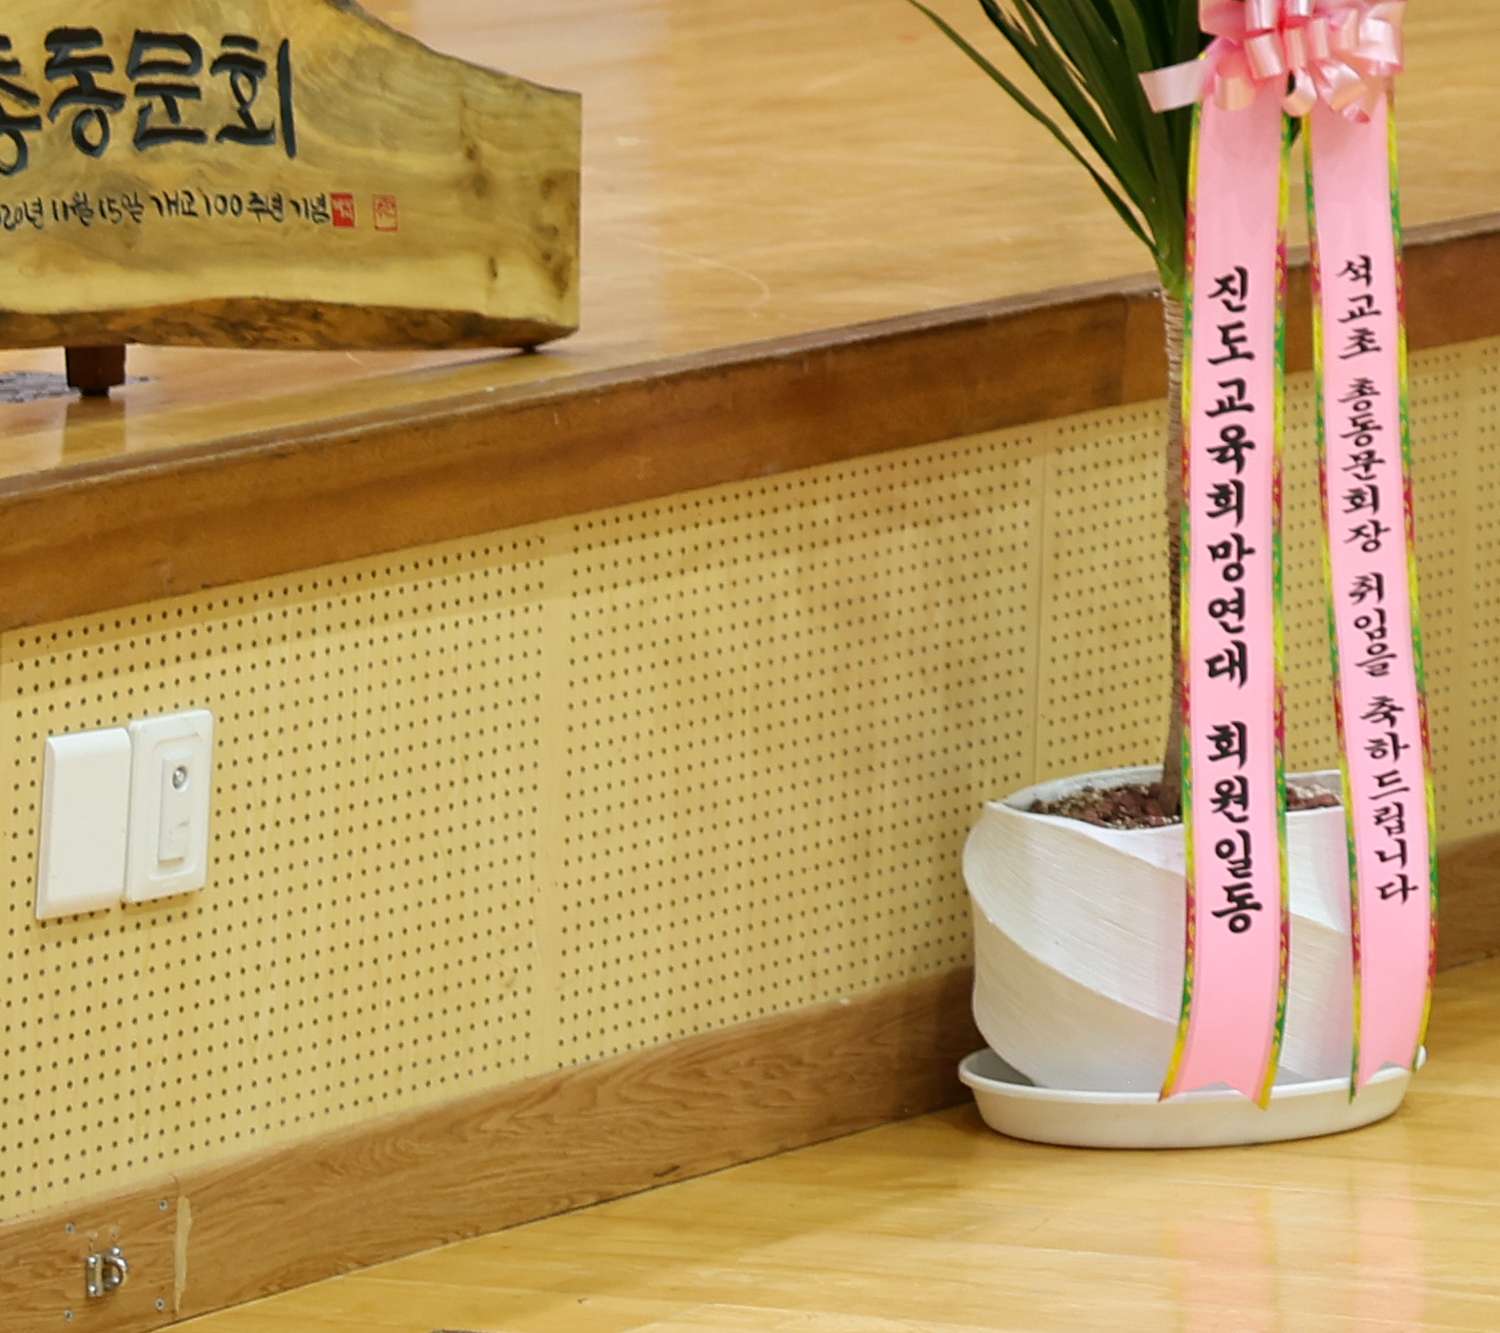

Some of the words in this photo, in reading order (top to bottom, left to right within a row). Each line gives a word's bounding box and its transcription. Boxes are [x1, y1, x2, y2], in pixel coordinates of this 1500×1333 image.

[1337, 254, 1383, 360] 석교초
[1204, 265, 1257, 689] 진도교육희망연대
[1337, 377, 1391, 553] 총동문회장
[1348, 571, 1398, 677] 취임을
[1359, 695, 1420, 905] 축하드립니다
